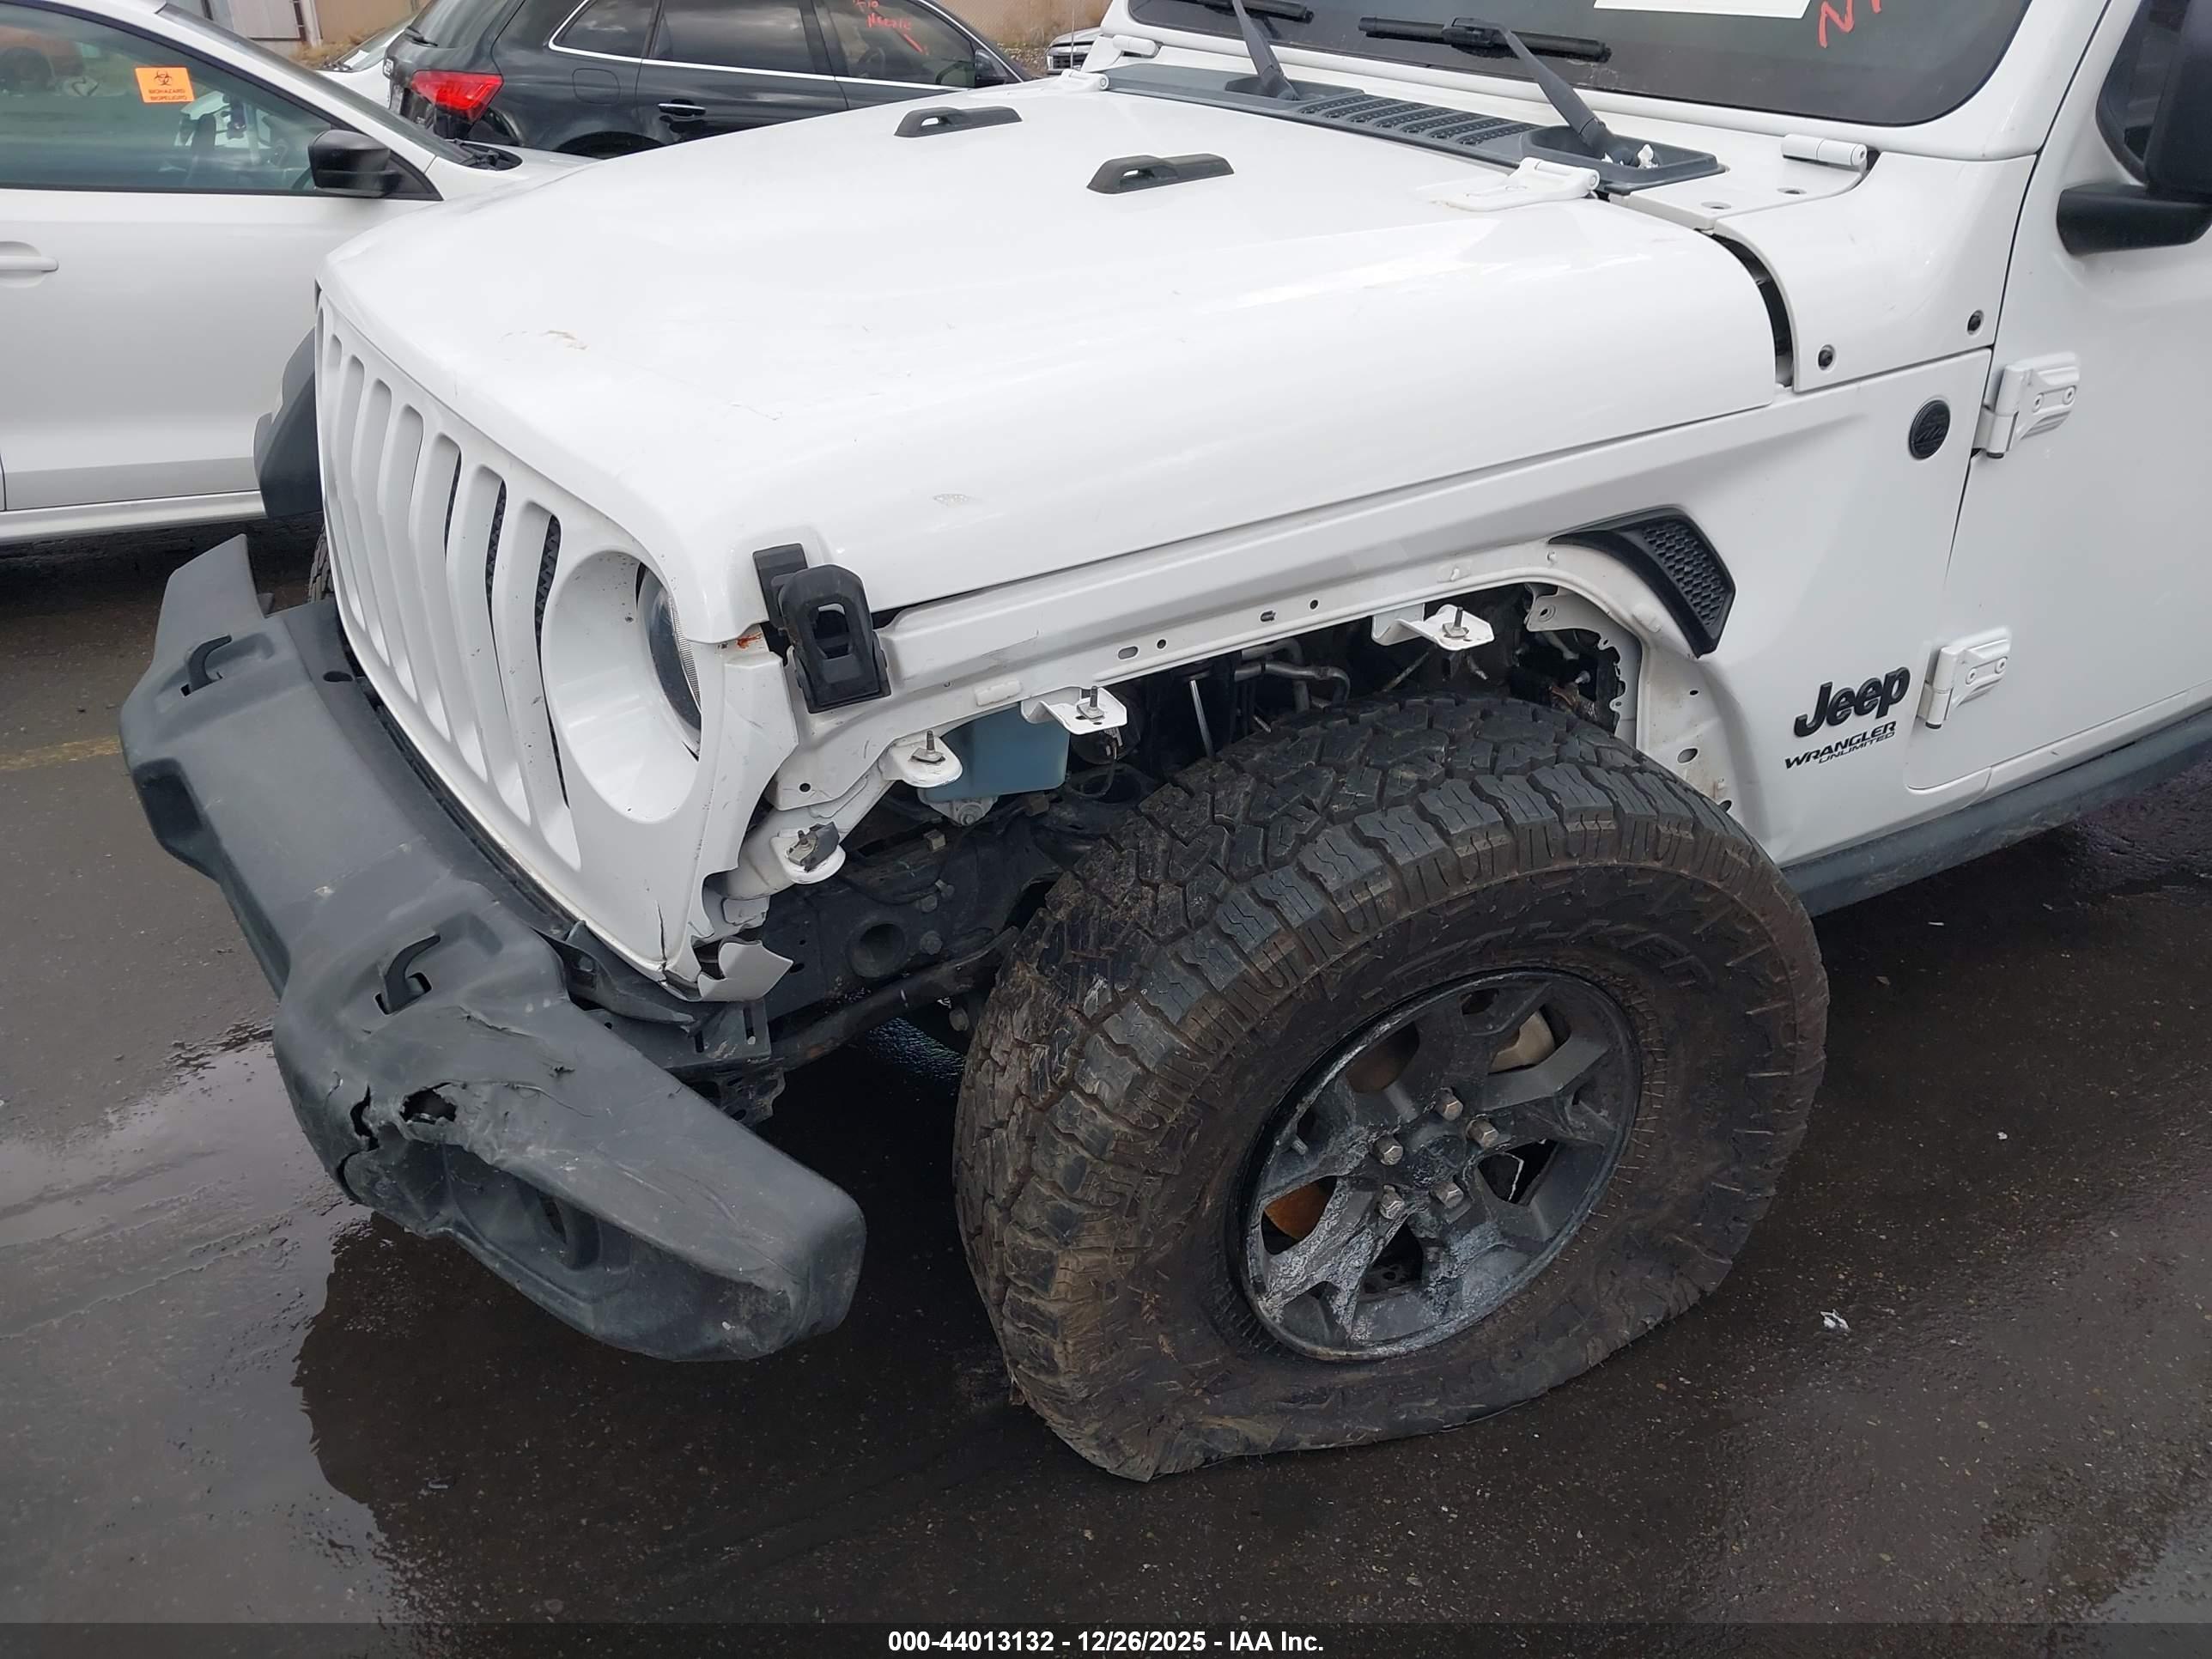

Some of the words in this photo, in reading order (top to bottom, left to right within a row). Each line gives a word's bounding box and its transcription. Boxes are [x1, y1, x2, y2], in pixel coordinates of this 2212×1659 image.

[1794, 666, 1911, 738] Jeep
[1785, 720, 1897, 769] WRANGLER
[1818, 731, 1896, 763] UNLIMITED
